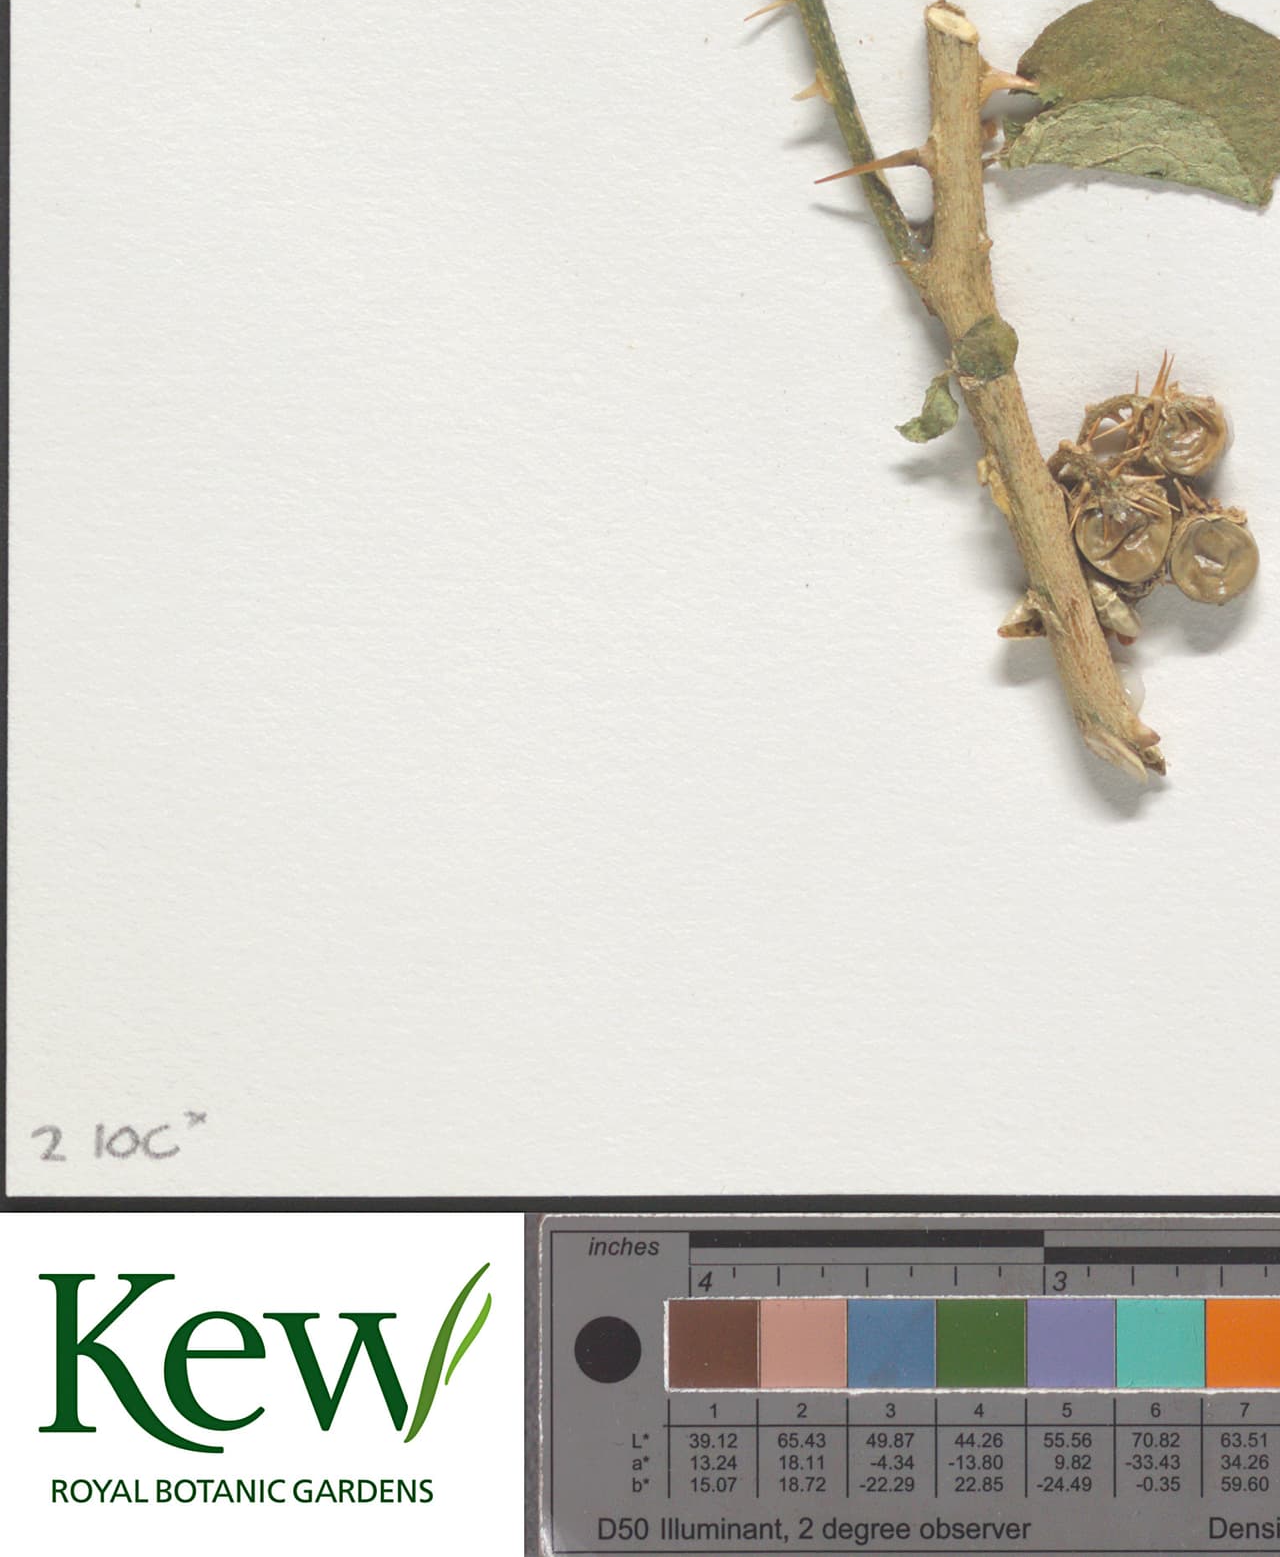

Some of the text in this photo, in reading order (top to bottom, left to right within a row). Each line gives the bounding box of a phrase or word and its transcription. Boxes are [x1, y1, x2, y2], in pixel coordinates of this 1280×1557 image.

[31, 1124, 67, 1162] 2
[588, 1235, 660, 1259] inches
[689, 1432, 738, 1449] 39.12
[778, 1432, 828, 1449] 65.43
[866, 1432, 916, 1449] 49.87
[954, 1432, 1004, 1449] 44.26
[598, 1515, 1031, 1545] D50 Illuminant, 2 degree observer
